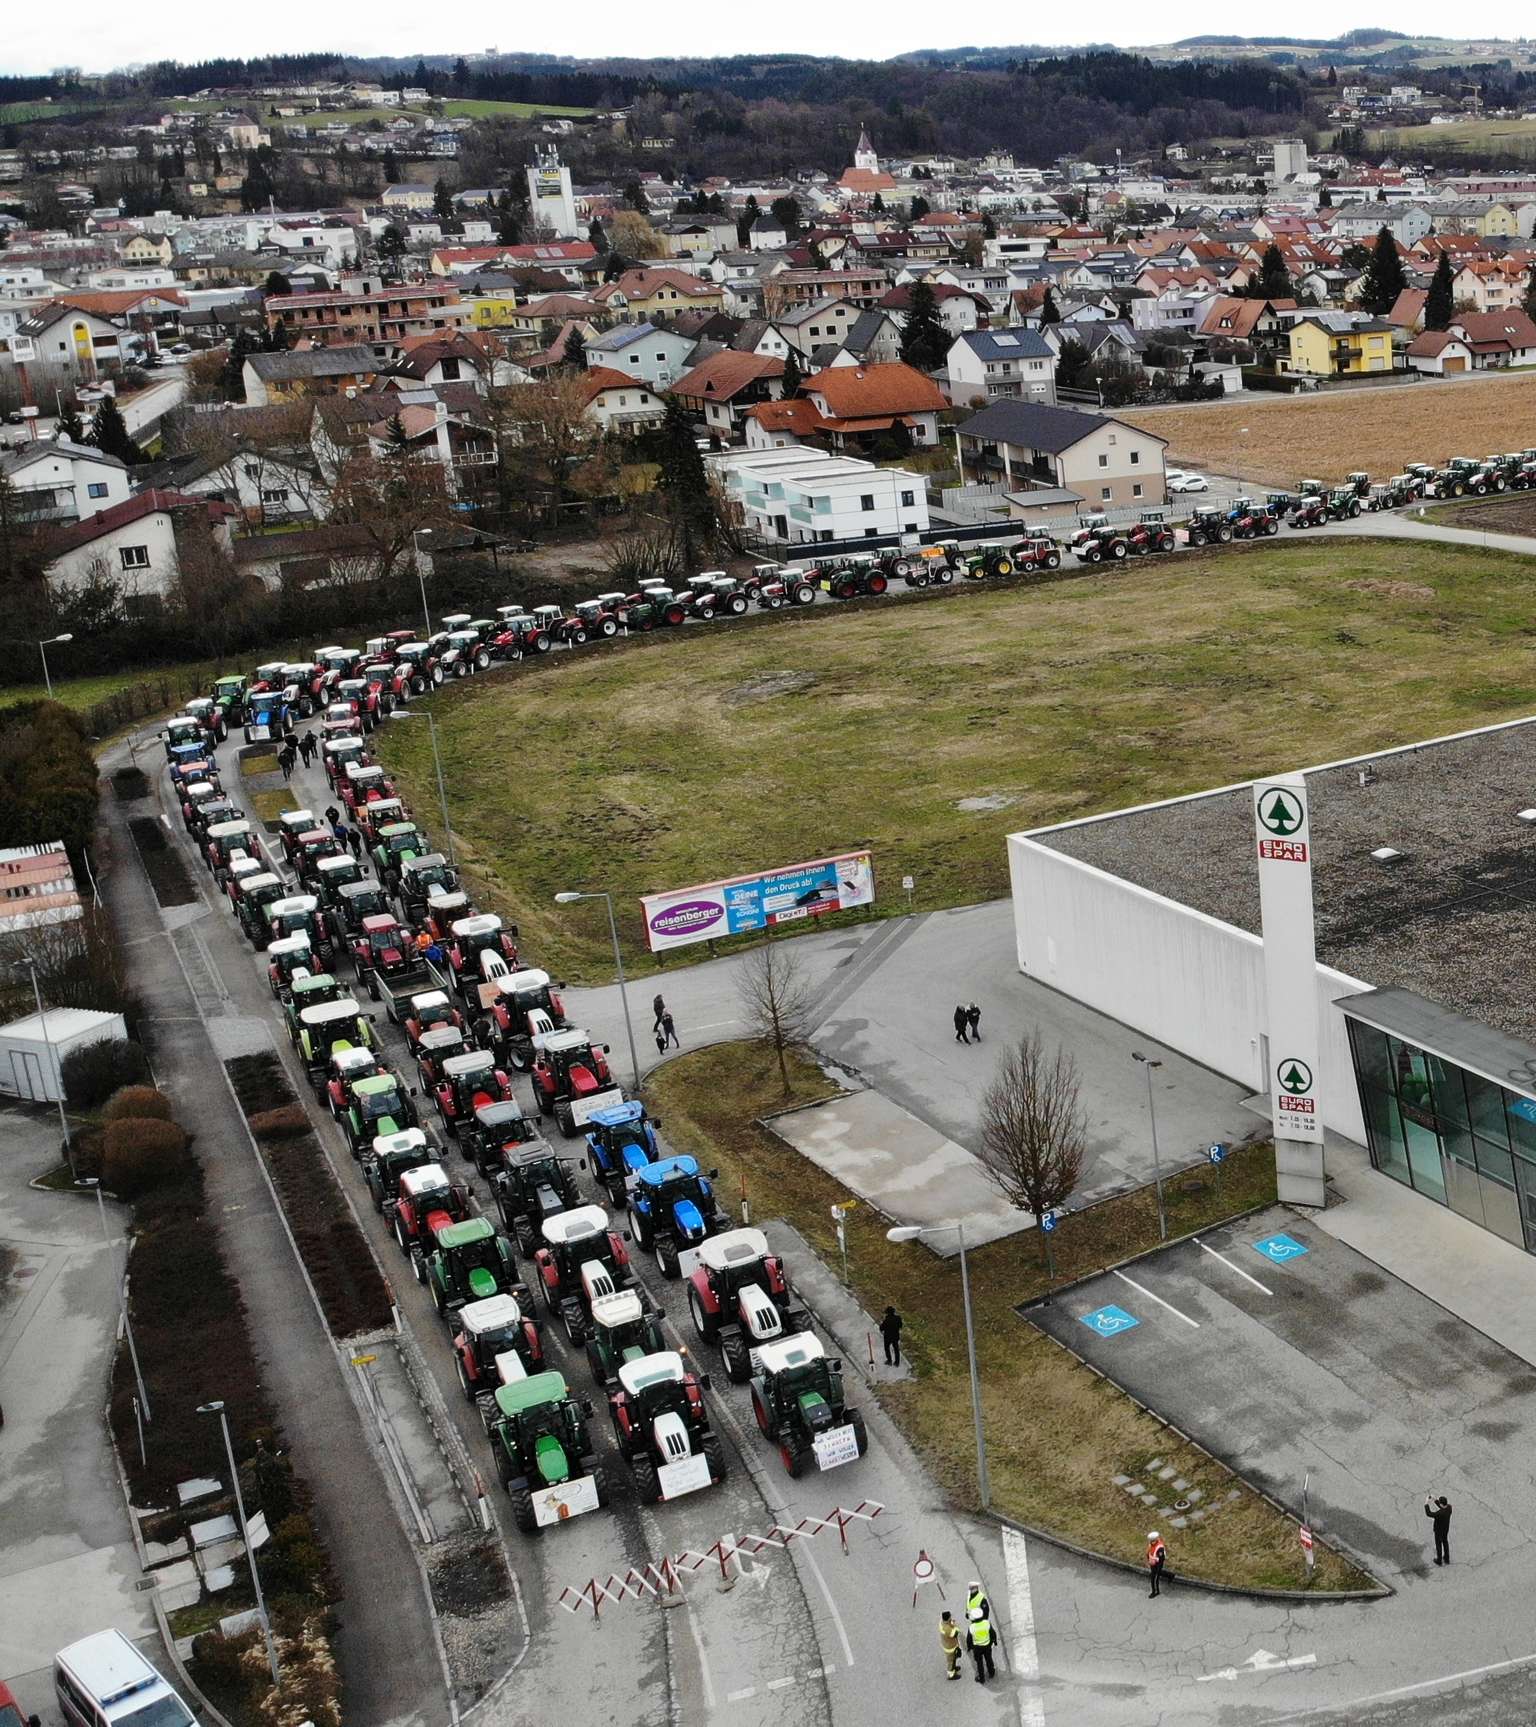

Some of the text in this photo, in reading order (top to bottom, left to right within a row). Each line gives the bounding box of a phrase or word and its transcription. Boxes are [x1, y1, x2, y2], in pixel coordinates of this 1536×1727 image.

[1263, 841, 1303, 851] EURO
[1263, 849, 1304, 860] SPAR
[655, 906, 720, 927] reisenberger
[1281, 1097, 1312, 1105] EURO
[1281, 1103, 1312, 1112] SPAR
